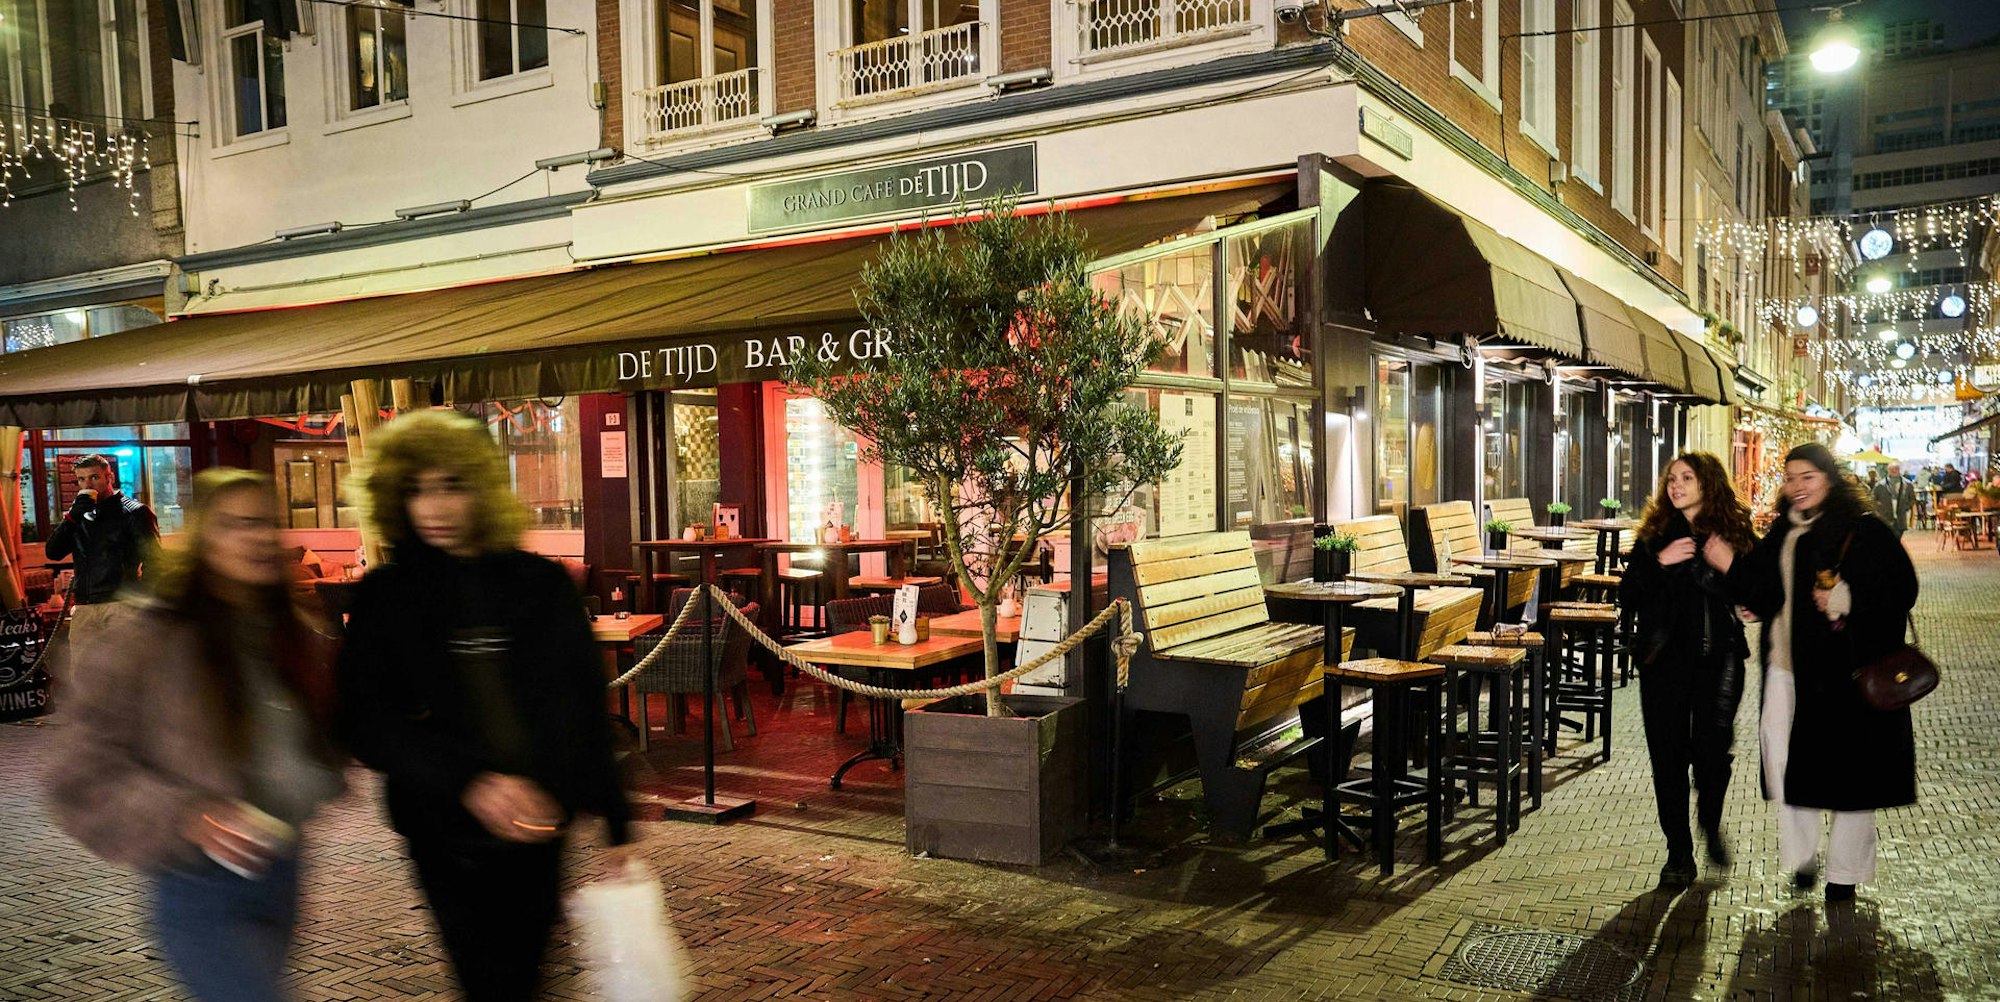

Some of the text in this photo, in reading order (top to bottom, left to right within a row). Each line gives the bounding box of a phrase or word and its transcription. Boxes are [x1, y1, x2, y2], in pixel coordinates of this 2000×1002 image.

[783, 187, 847, 214] GRAND
[850, 177, 895, 203] CAFÉ
[617, 350, 651, 380] DE
[658, 344, 717, 383] TIJD
[817, 332, 841, 363] &
